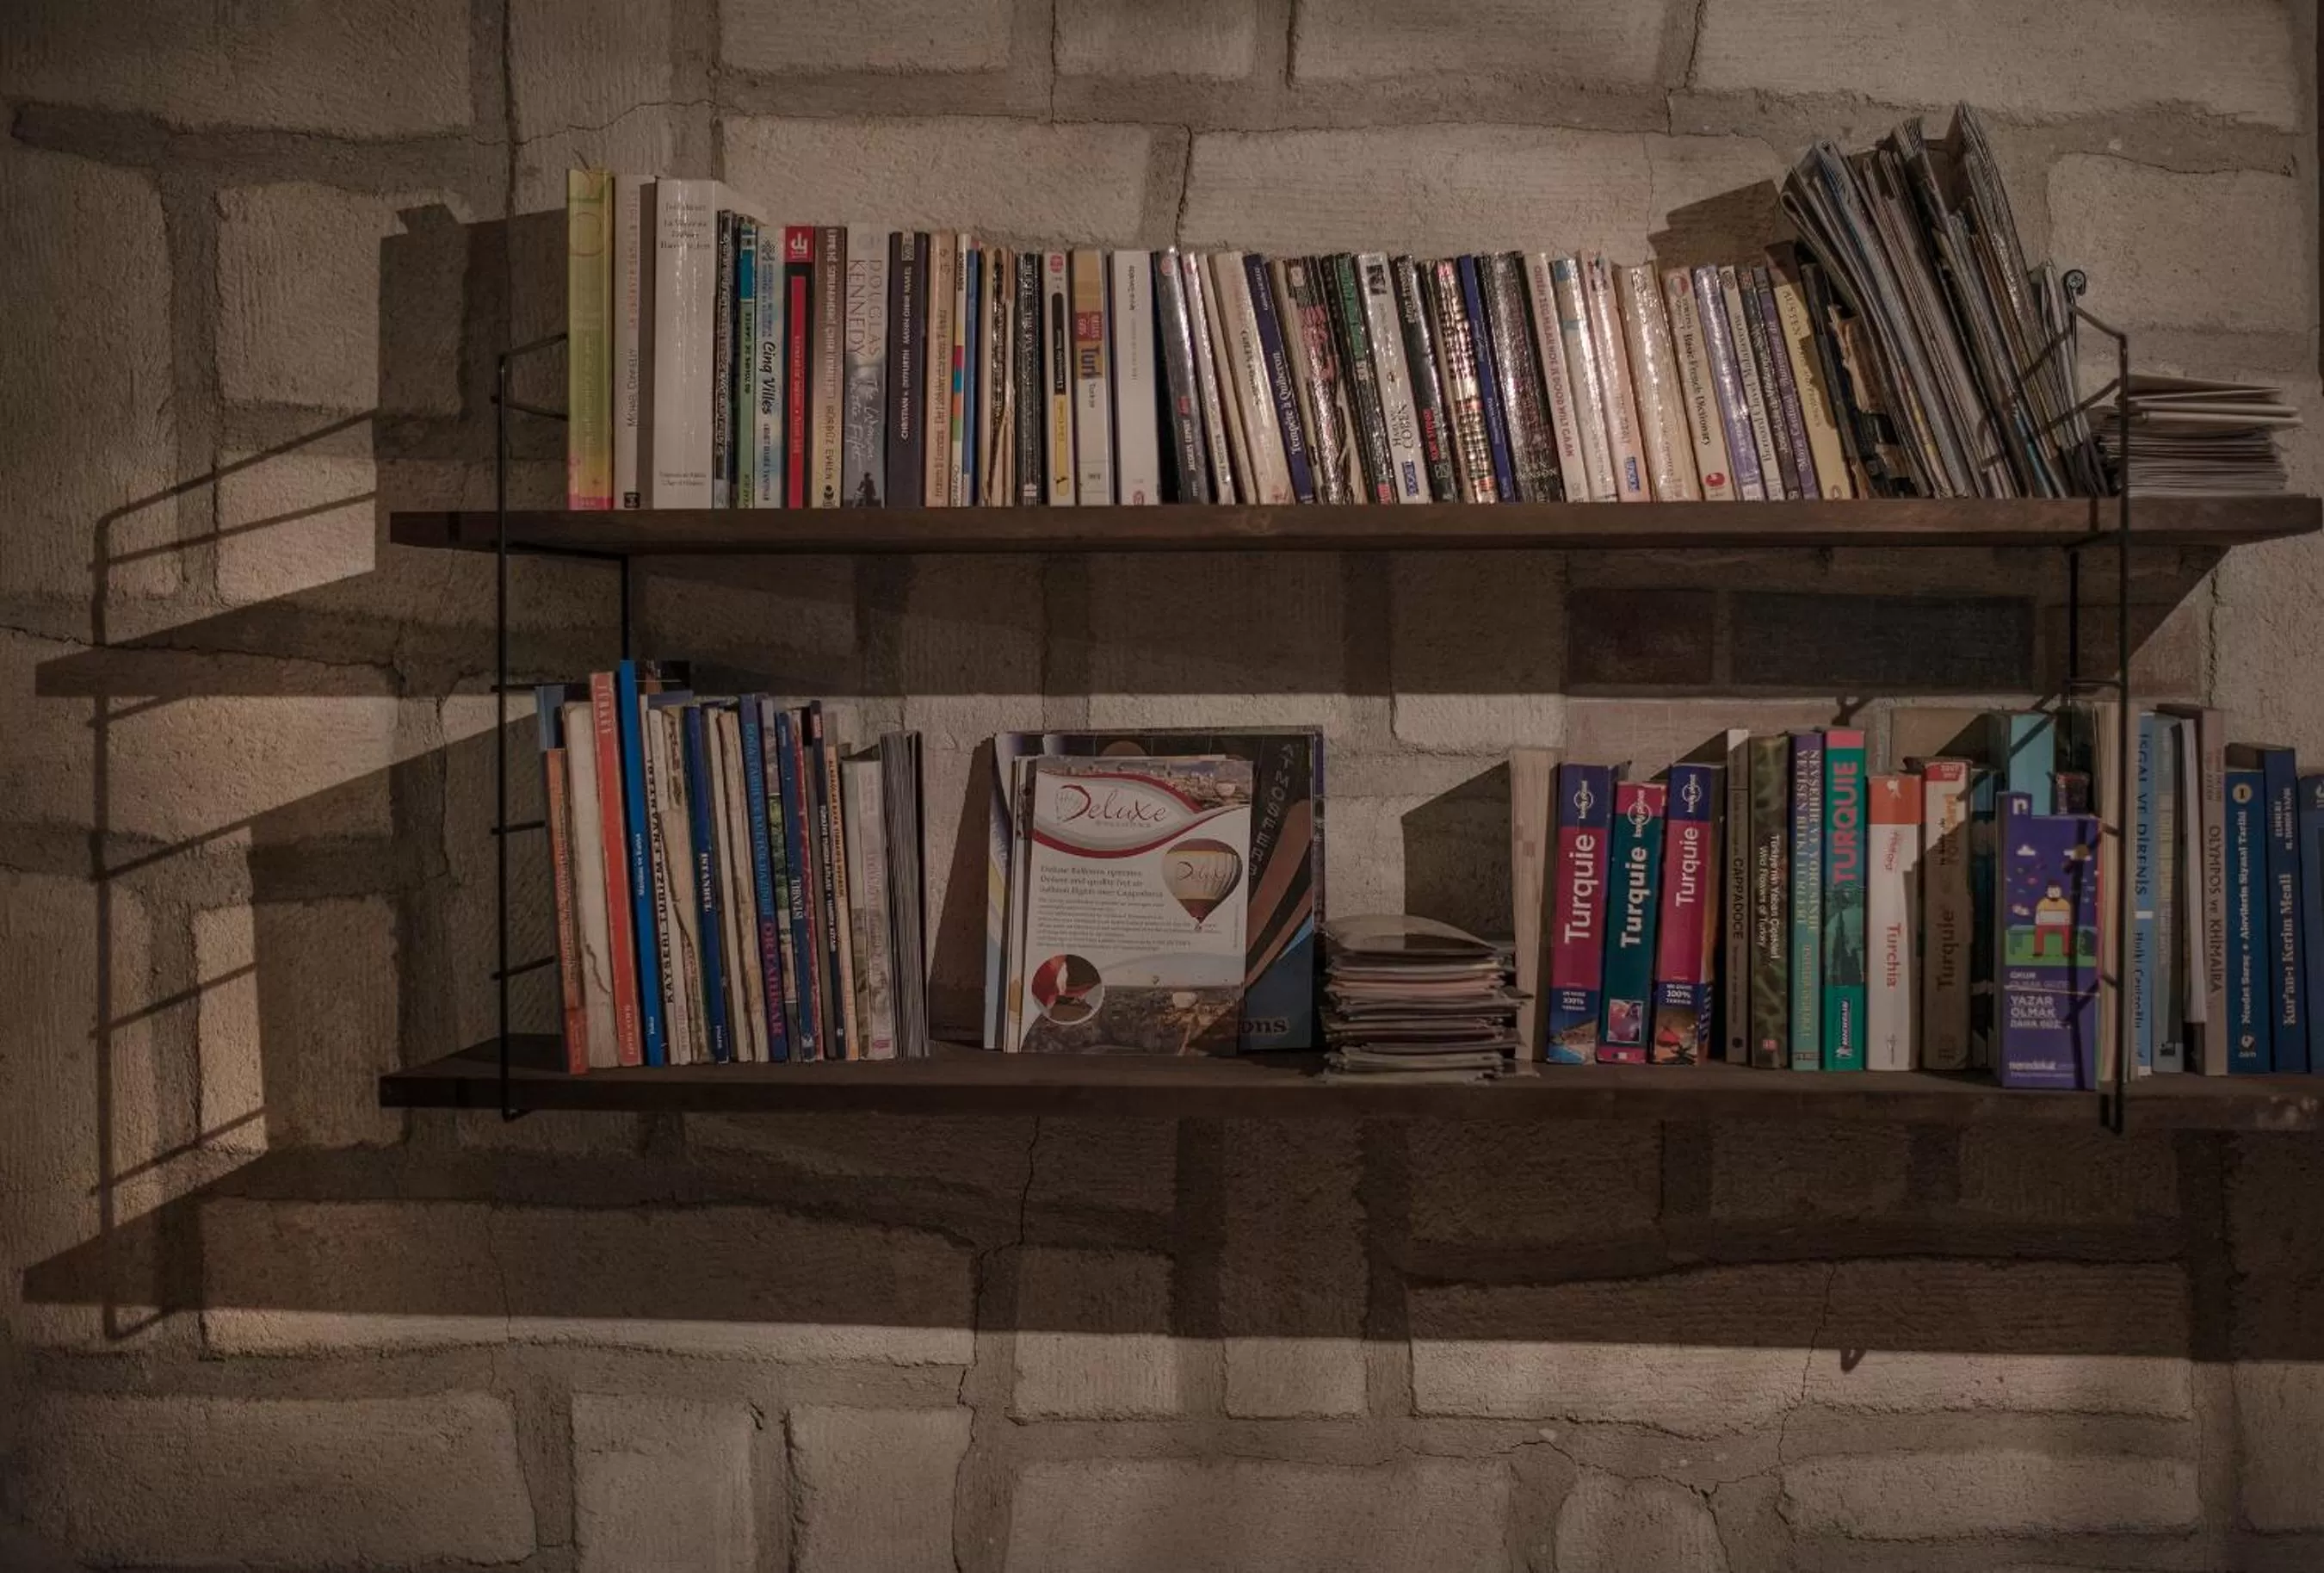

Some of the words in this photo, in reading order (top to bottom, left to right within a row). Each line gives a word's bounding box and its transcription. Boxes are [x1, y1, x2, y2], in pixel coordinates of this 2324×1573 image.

[849, 259, 865, 356] KENNEDY
[868, 259, 882, 356] DOUGLAS
[758, 340, 776, 373] Cinq
[1272, 350, 1290, 400] Quiberon
[761, 377, 776, 415] Villes
[1551, 375, 1567, 406] DOOD
[1684, 332, 1698, 359] Basic
[1695, 395, 1711, 446] Dictionary
[900, 397, 909, 441] CHRISTIAN
[1282, 409, 1303, 455] Tempête
[1556, 406, 1571, 427] WILT
[1785, 394, 1802, 437] Cardinal
[1184, 443, 1196, 471] JACQUES
[1561, 428, 1575, 457] GAAN
[1752, 419, 1772, 462] Bernard
[1794, 438, 1808, 472] Marie
[1795, 749, 1808, 811] YETİŞEN
[1807, 748, 1821, 823] NEVŞEHİR
[1060, 784, 1167, 823] Deluxe
[1832, 761, 1858, 883] TURQUIE
[1631, 814, 1646, 837] lonely
[2237, 810, 2247, 845] Tarihi
[1675, 827, 1700, 907] Turquie
[1757, 846, 1770, 866] Wild
[1768, 833, 1782, 884] Türkiye'nin
[2207, 825, 2222, 895] OLYMPOS
[2237, 846, 2248, 884] Siyasal
[1563, 833, 1598, 944] Turquie
[1619, 845, 1650, 949] Turquie
[1732, 858, 1746, 940] CAPPADOCE
[1757, 868, 1770, 902] Flowers
[1770, 887, 1781, 916] Yaban
[2278, 872, 2295, 914] Meali
[1756, 915, 1770, 946] Turkey
[1937, 909, 1963, 992] Turquie
[2280, 918, 2296, 962] Kerim
[1884, 922, 1901, 988] Turchia
[2208, 919, 2225, 993] KHİMAİRA
[2010, 994, 2055, 1006] YAZAR
[2010, 1006, 2056, 1018] OLMAK
[2282, 965, 2297, 1025] Kur'an-ı
[2010, 1019, 2037, 1029] DAHA
